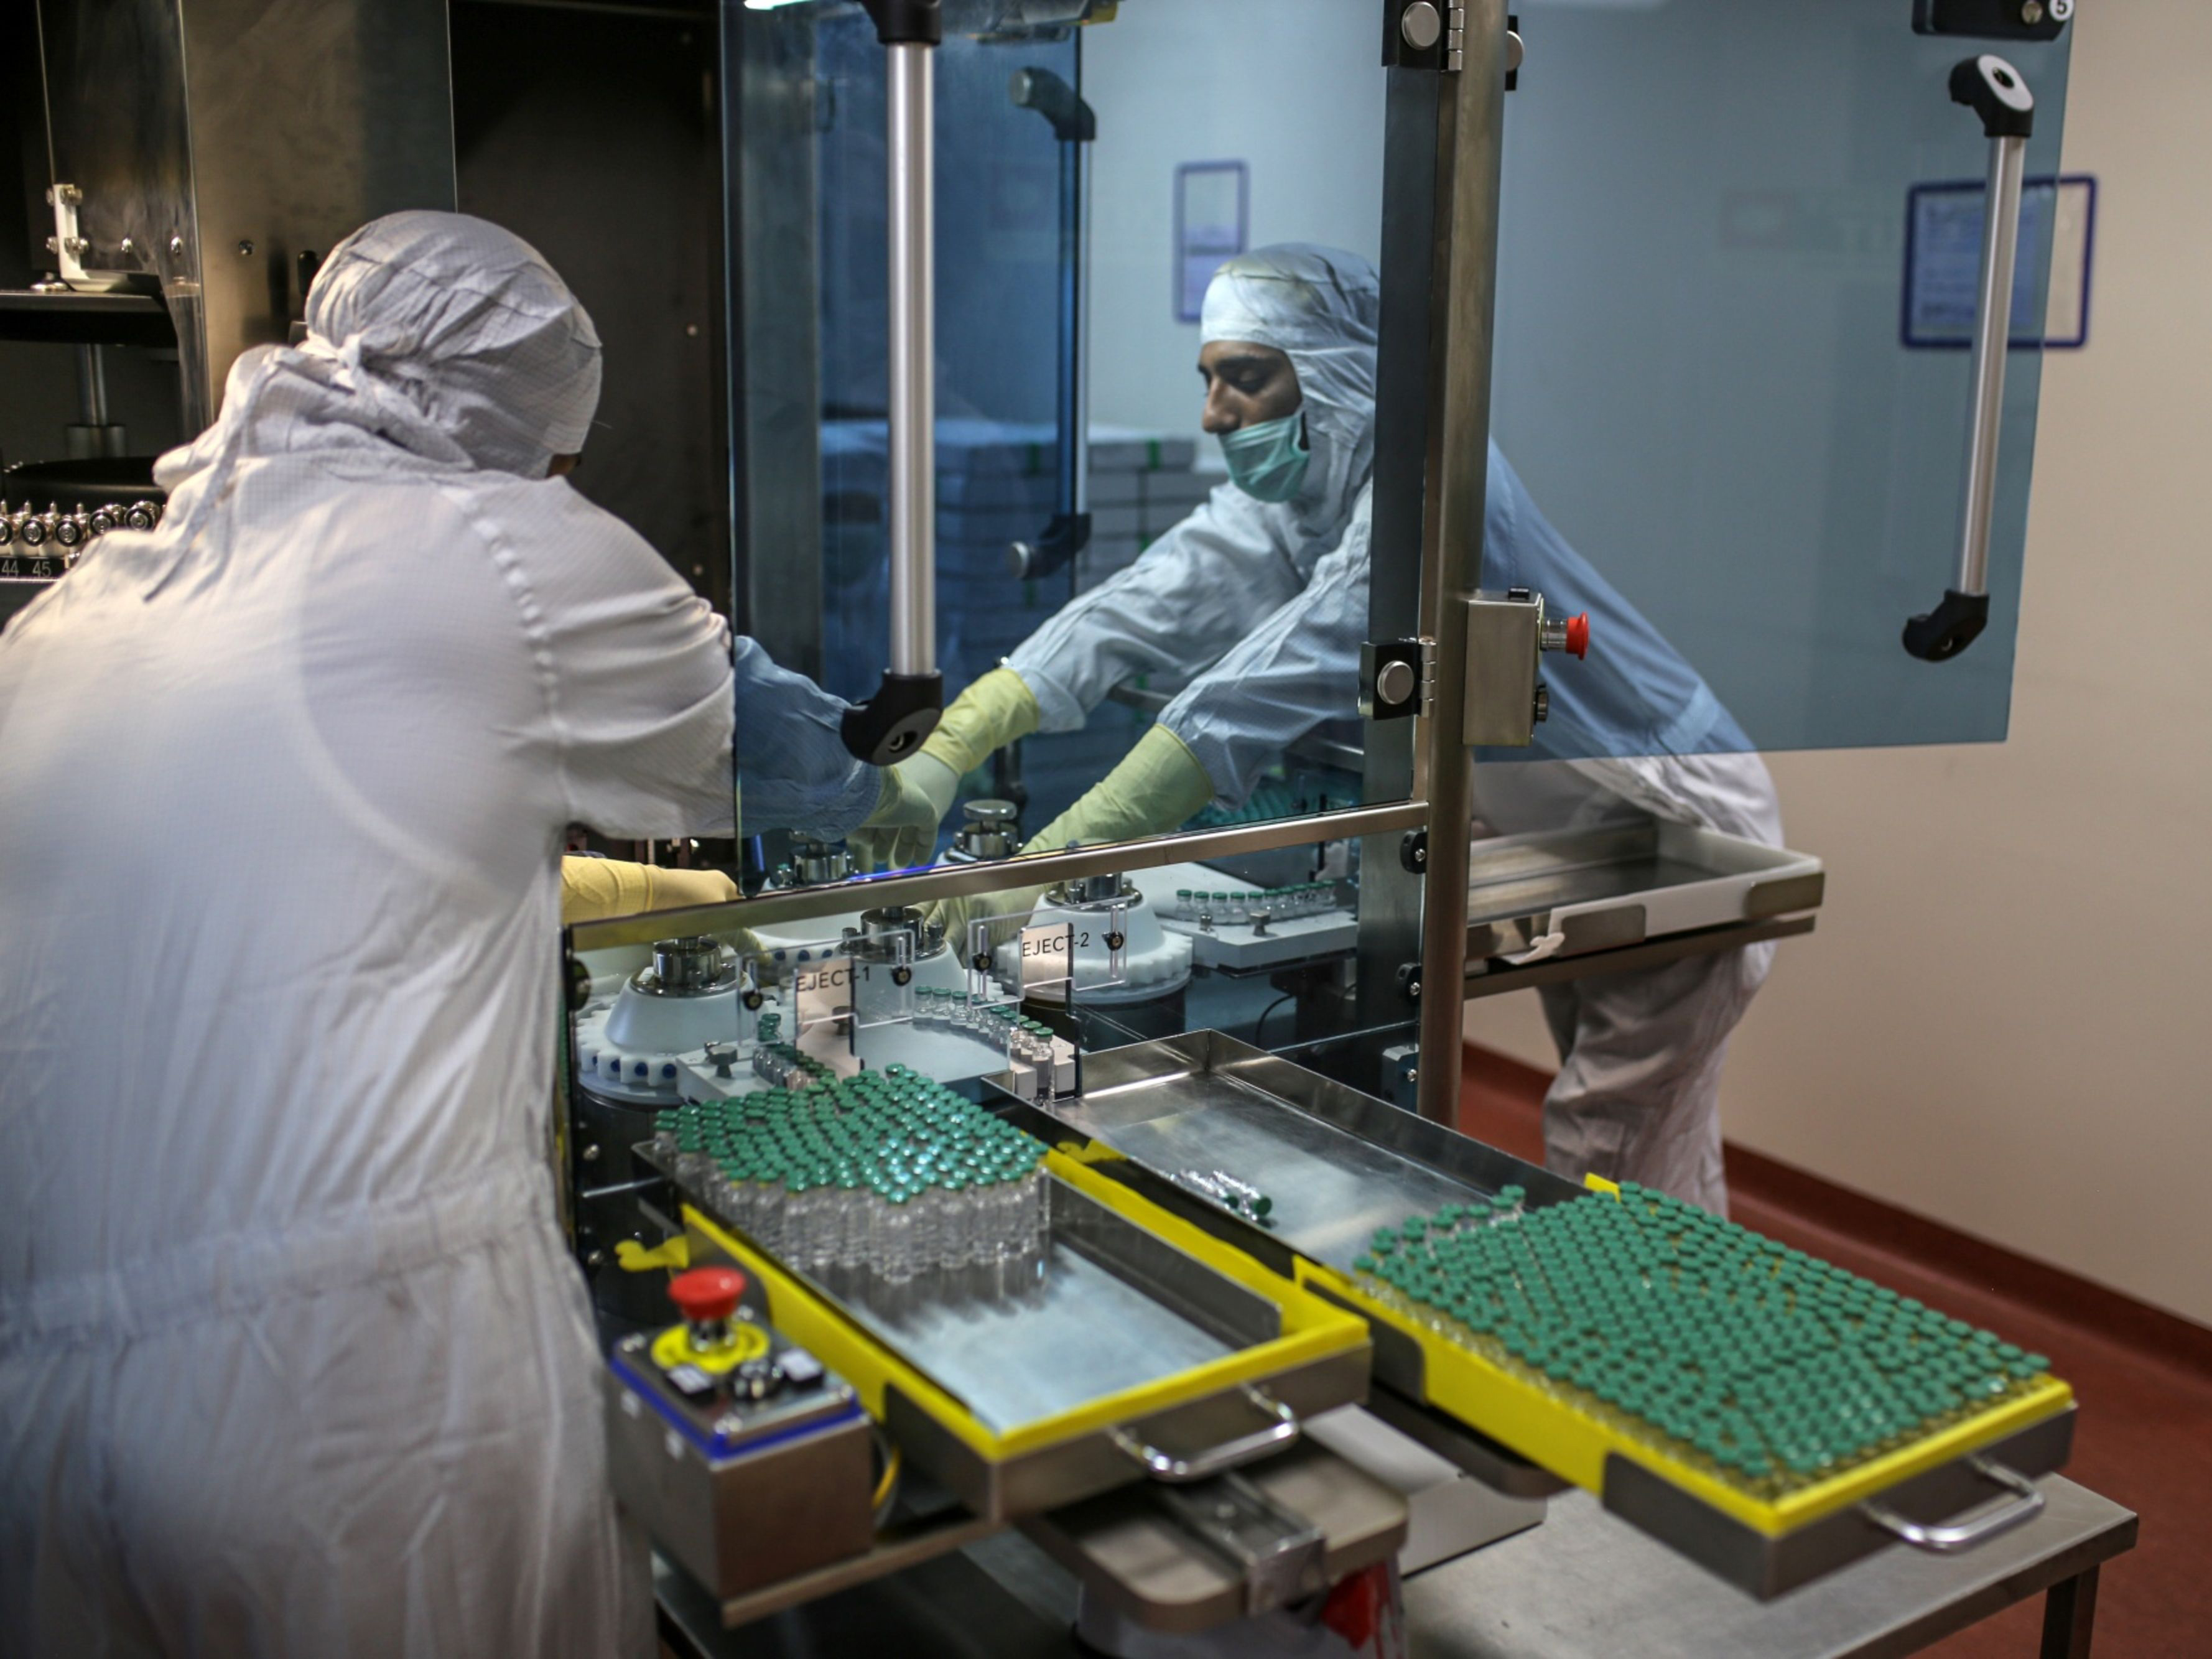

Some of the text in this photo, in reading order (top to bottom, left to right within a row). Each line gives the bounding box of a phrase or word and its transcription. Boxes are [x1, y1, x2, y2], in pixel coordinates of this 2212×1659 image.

[1, 560, 52, 578] 44 45
[1022, 932, 1089, 957] EJECT-2
[796, 965, 870, 992] EJECT-1
